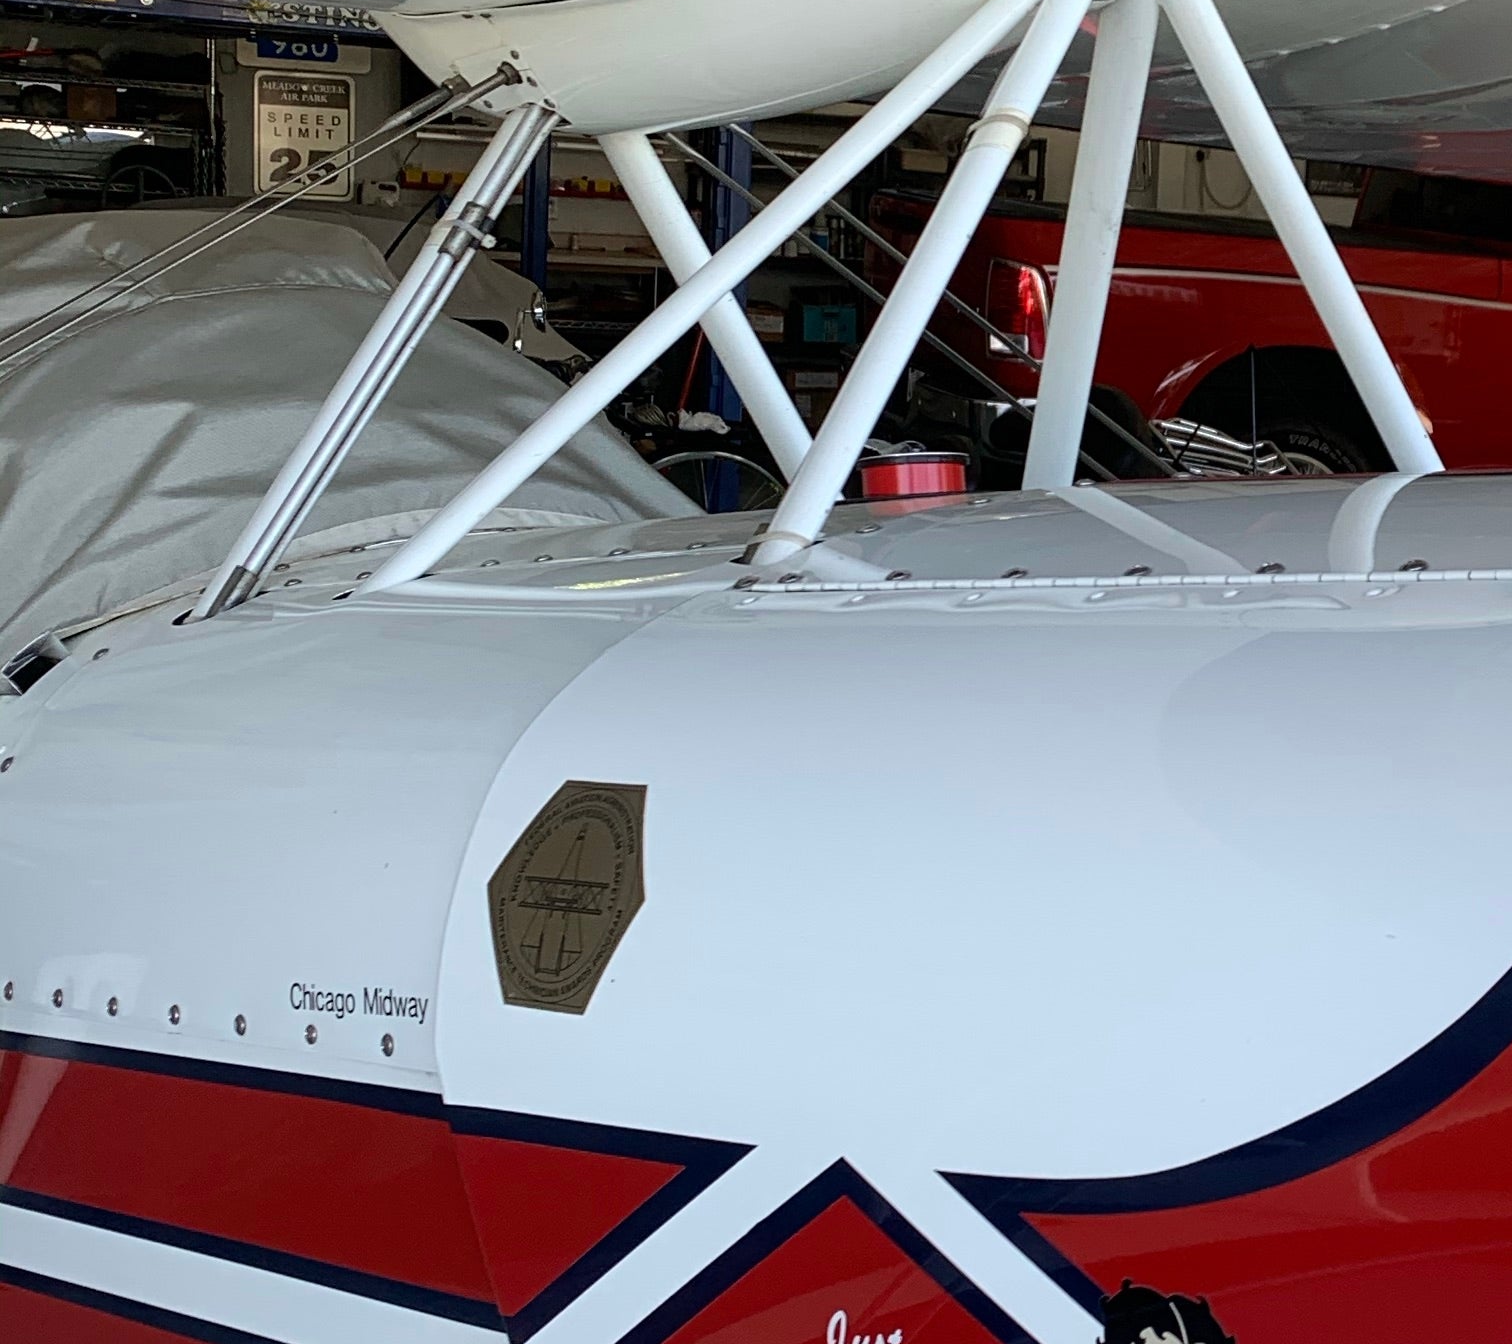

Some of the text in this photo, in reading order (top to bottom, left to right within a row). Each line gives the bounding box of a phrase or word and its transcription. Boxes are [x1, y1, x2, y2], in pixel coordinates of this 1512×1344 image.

[312, 83, 346, 95] CREEK
[280, 92, 329, 104] AIR PARK
[267, 111, 342, 127] SPEED
[273, 126, 335, 140] LIMIT
[269, 147, 340, 187] 25
[289, 982, 430, 1025] Chicago Midway
